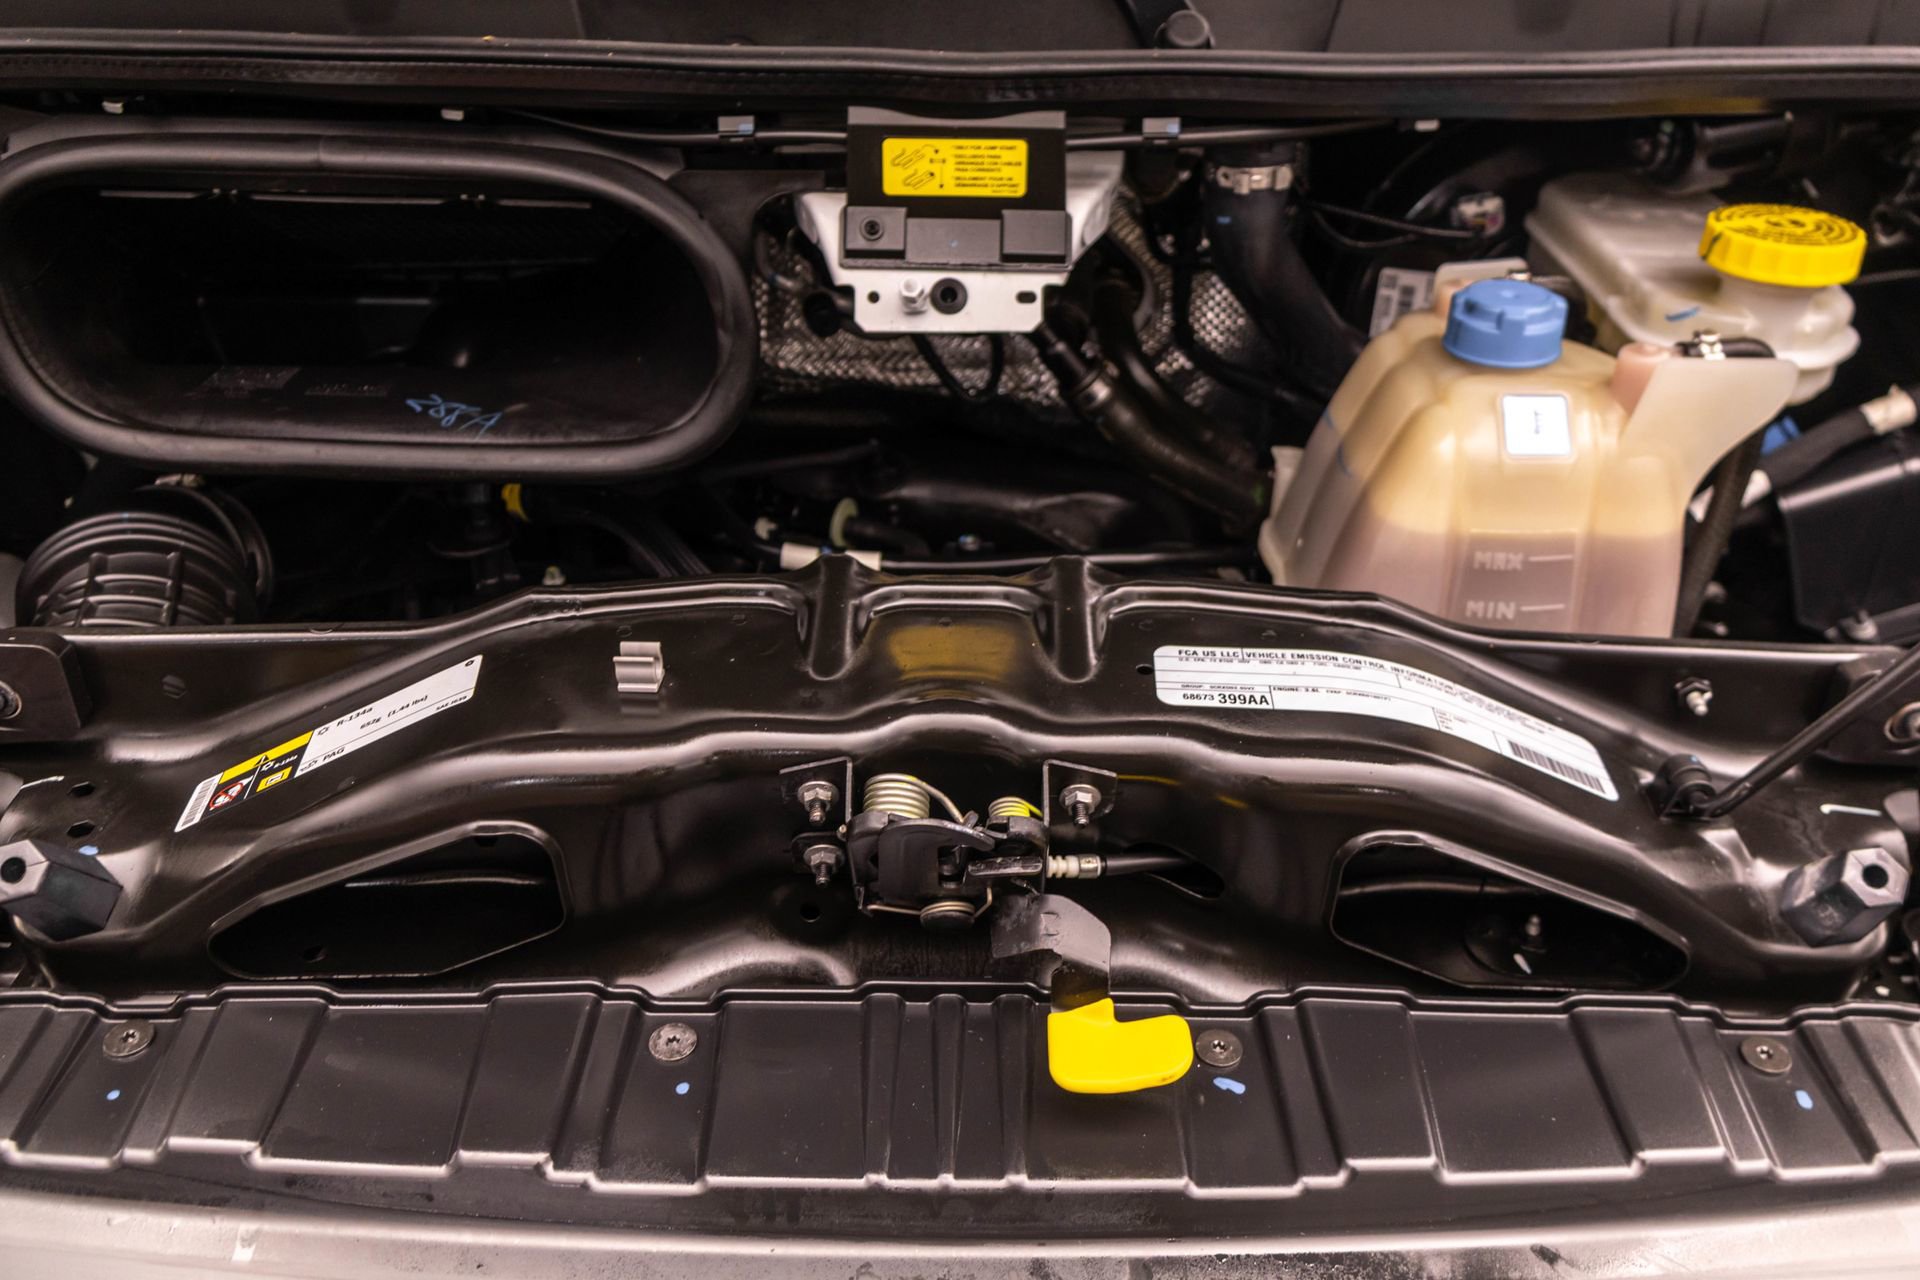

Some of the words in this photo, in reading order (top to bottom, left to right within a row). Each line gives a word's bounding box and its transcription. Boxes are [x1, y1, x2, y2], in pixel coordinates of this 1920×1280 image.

[1473, 551, 1523, 571] MAX
[1465, 600, 1516, 619] MIN
[1245, 651, 1287, 659] VEHICLE
[1291, 653, 1339, 662] EMISSION
[1342, 656, 1386, 670] CONTROL
[1182, 693, 1215, 701] 68673
[1218, 693, 1270, 706] 399AA
[322, 748, 345, 762] PAG
